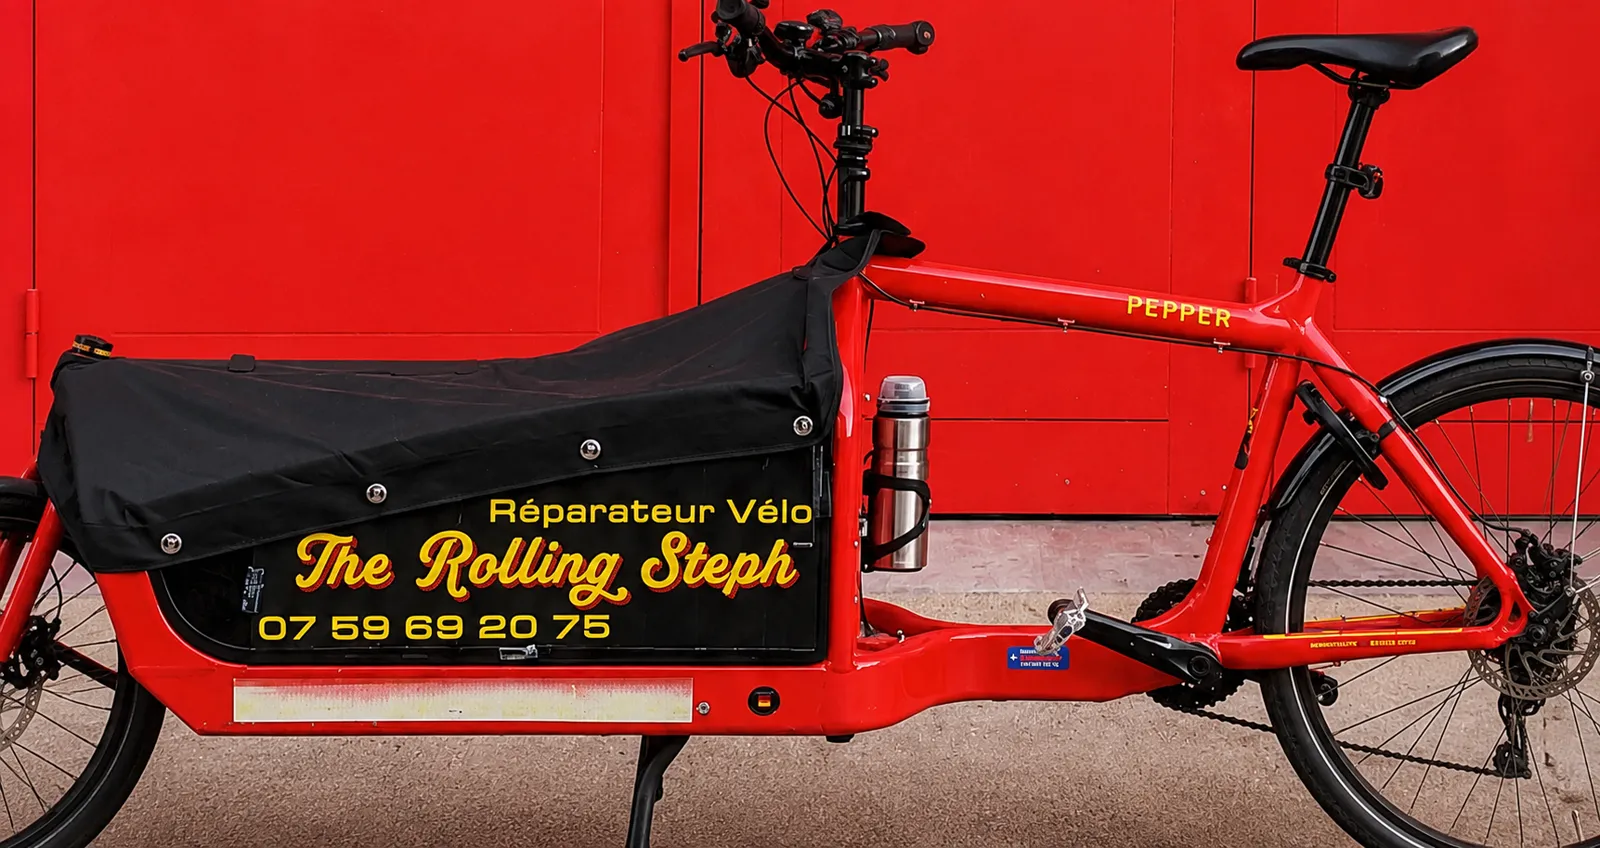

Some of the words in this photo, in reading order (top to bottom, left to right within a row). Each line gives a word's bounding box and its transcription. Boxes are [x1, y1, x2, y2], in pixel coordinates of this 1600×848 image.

[1127, 295, 1231, 327] PEPPER
[489, 498, 715, 529] Réparateur
[727, 498, 813, 524] Vélo
[295, 533, 394, 592] The
[416, 530, 630, 610] Rolling
[641, 530, 800, 599] Steph
[259, 615, 316, 640] 07
[332, 615, 389, 640] 59
[406, 615, 463, 640] 69
[479, 615, 537, 639] 20
[553, 615, 610, 640] 75
